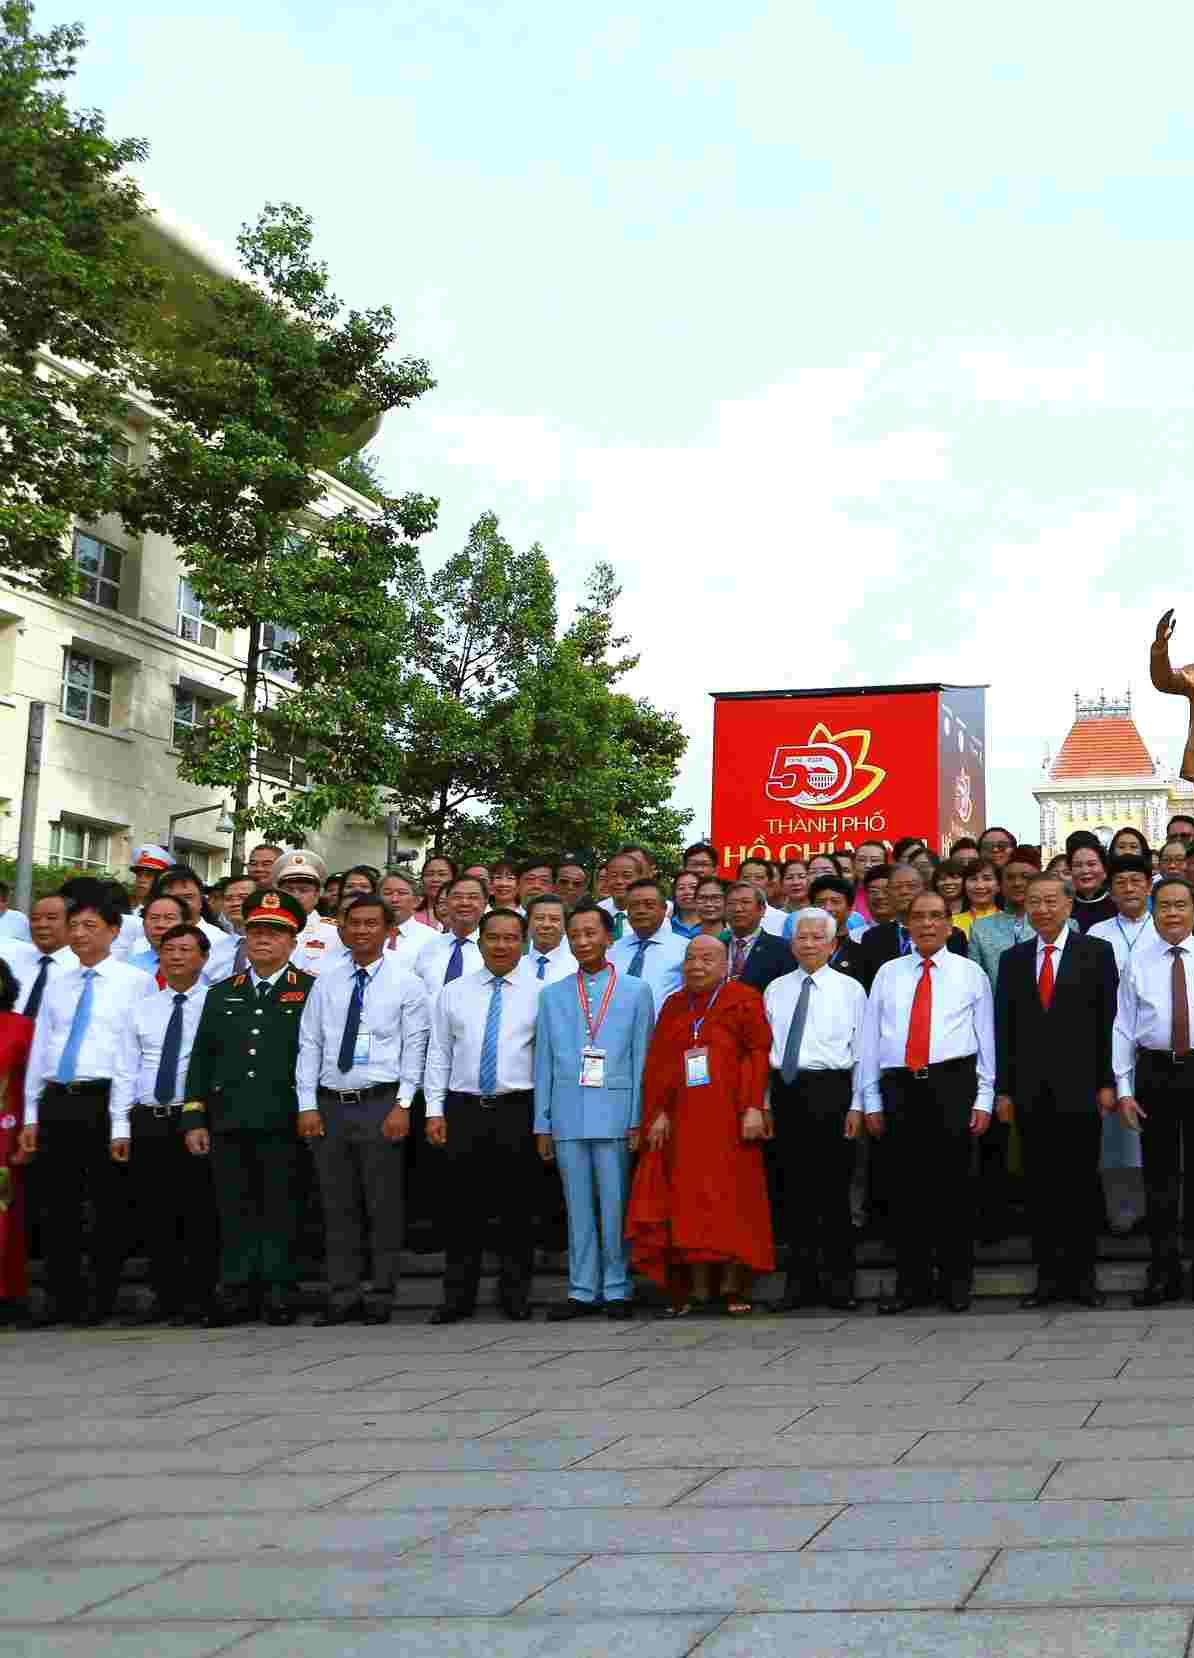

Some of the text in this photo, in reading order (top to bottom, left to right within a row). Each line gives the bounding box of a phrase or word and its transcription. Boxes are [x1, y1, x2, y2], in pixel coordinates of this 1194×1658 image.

[766, 742, 852, 804] 50
[765, 808, 886, 834] THÀNH PHỐ
